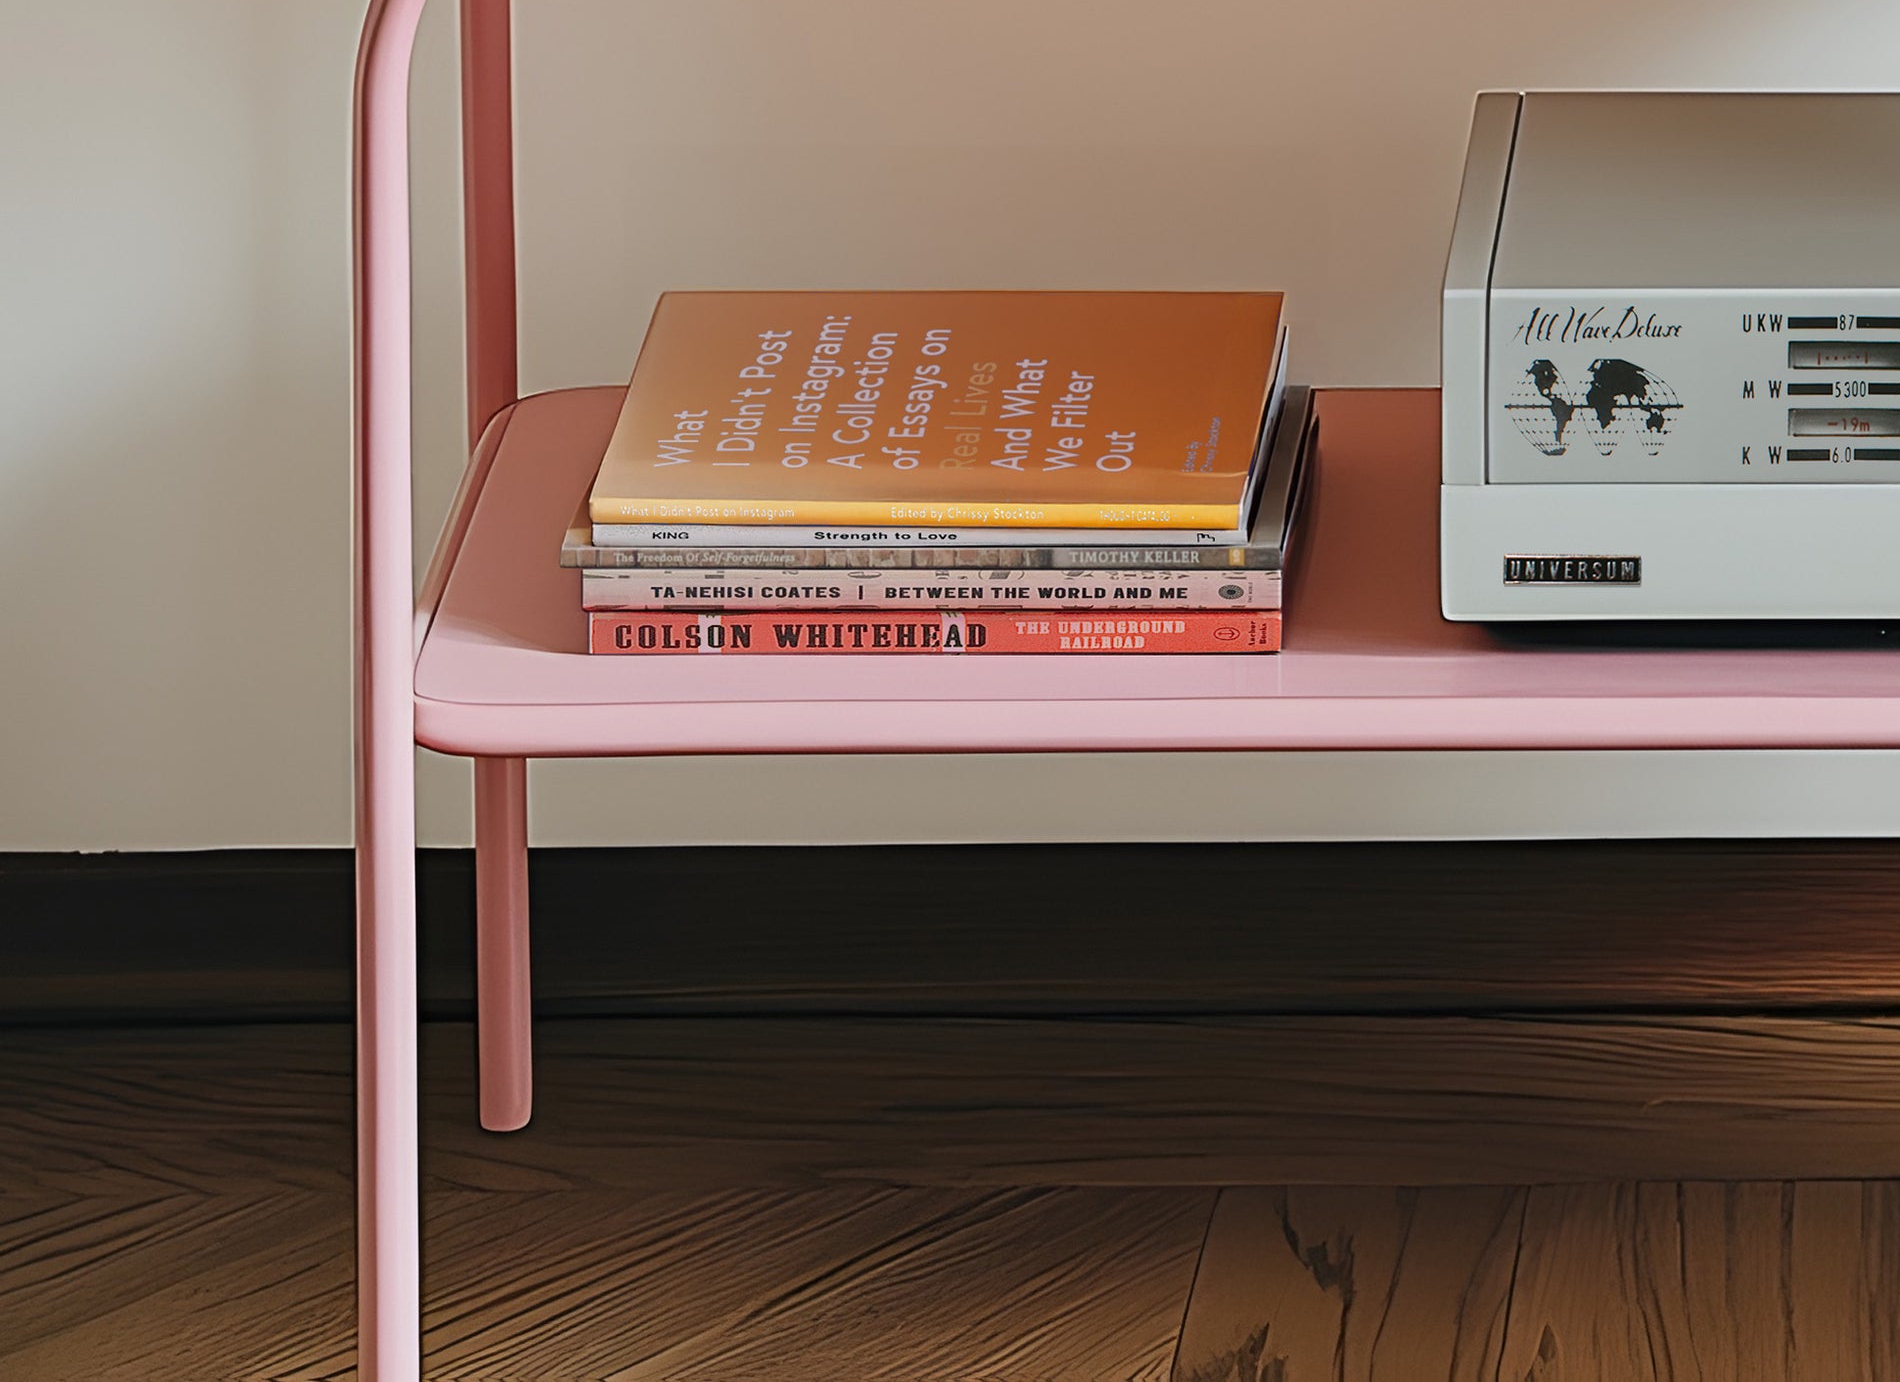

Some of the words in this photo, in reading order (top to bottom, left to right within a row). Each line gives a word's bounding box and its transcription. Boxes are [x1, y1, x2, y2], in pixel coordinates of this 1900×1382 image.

[1742, 313, 1783, 333] UKW
[1839, 314, 1855, 331] 87
[738, 330, 793, 378] Post
[921, 329, 952, 356] on
[778, 315, 852, 432] Instagram:
[831, 332, 899, 444] Collection
[950, 362, 998, 416] Lives
[1000, 359, 1049, 419] What
[1051, 371, 1094, 428] Filter
[1834, 381, 1867, 398] 5300
[887, 365, 948, 438] Essays
[716, 387, 772, 451] Didn't
[653, 410, 708, 467] What
[937, 426, 983, 470] Real
[990, 428, 1033, 471] And
[781, 443, 812, 469] on
[826, 453, 866, 470] A
[881, 446, 921, 470] of
[1042, 437, 1084, 472] We
[1096, 431, 1136, 472] Out
[1832, 447, 1852, 463] 6.0
[620, 505, 649, 516] What
[660, 505, 692, 517] Didn't
[695, 506, 720, 517] Post
[723, 509, 737, 517] on
[740, 507, 795, 521] Instagram
[891, 507, 927, 519] Edited
[930, 507, 943, 522] by
[947, 507, 989, 522] Chrissy
[994, 507, 1044, 520] Stockton
[652, 531, 689, 540] KING
[814, 531, 888, 542] Strength
[894, 532, 911, 540] to
[918, 532, 958, 541] Love
[614, 553, 635, 563] The
[637, 552, 683, 563] Freedom
[1069, 550, 1140, 564] TIMOTHY
[1144, 550, 1201, 564] KELLER
[1509, 560, 1636, 580] UNIVERSUM
[651, 586, 753, 599] TA-NEHISI
[761, 586, 841, 599] COATES
[885, 586, 983, 599] BETWEEN
[991, 587, 1030, 599] THE
[1038, 587, 1106, 599] WORLD
[1113, 587, 1152, 599] AND
[1159, 587, 1188, 599] ME
[615, 624, 752, 649] COLSON
[773, 624, 987, 649] WHITEHEAD
[1015, 621, 1050, 635] THE
[1058, 621, 1186, 635] UNDERGROUND
[1060, 636, 1145, 650] RAILROAD
